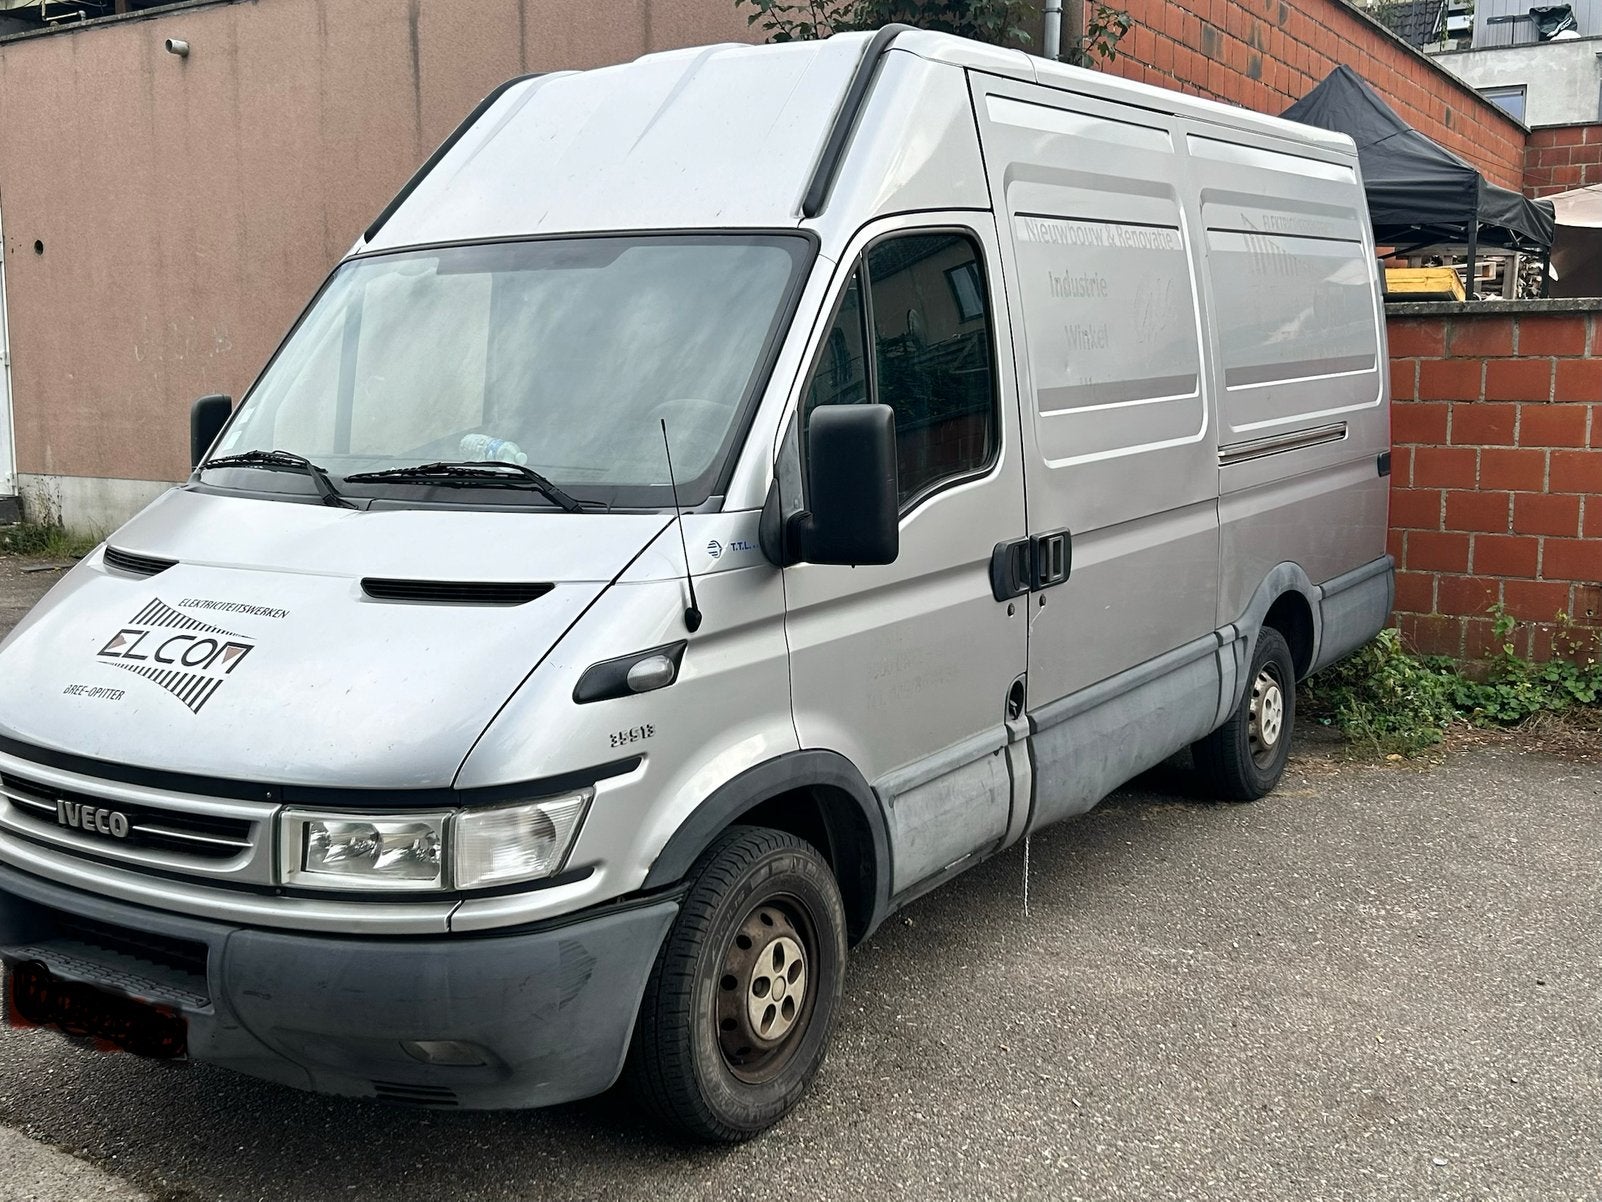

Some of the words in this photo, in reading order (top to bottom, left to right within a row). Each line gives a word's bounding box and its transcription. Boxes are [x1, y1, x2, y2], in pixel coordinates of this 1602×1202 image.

[1025, 218, 1103, 247] Nieuwbouw
[1104, 223, 1115, 247] &
[1116, 224, 1175, 250] Renovatie
[1049, 269, 1108, 299] Industrie
[178, 598, 290, 619] ELEKTRICITEITSWERKEN
[96, 628, 255, 675] ELCOM
[57, 800, 129, 838] IVECO
